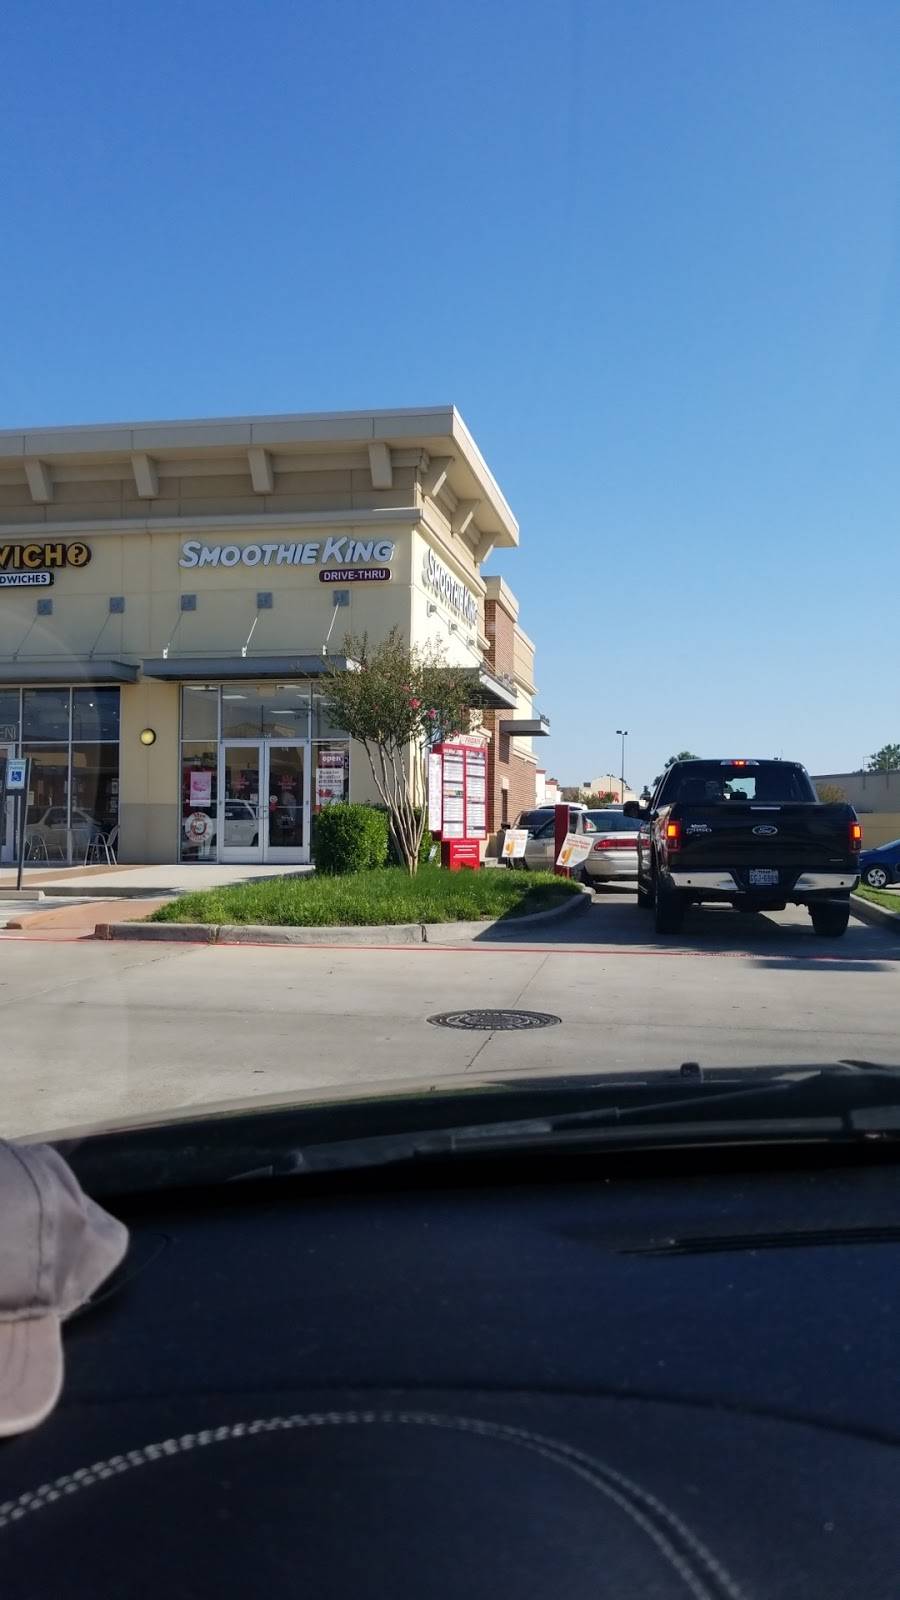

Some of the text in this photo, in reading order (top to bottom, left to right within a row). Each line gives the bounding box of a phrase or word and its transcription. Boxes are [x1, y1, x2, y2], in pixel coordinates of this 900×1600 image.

[178, 540, 320, 568] SMOOTHIE
[323, 569, 386, 581] DRIVE-THRU
[322, 755, 342, 764] open
